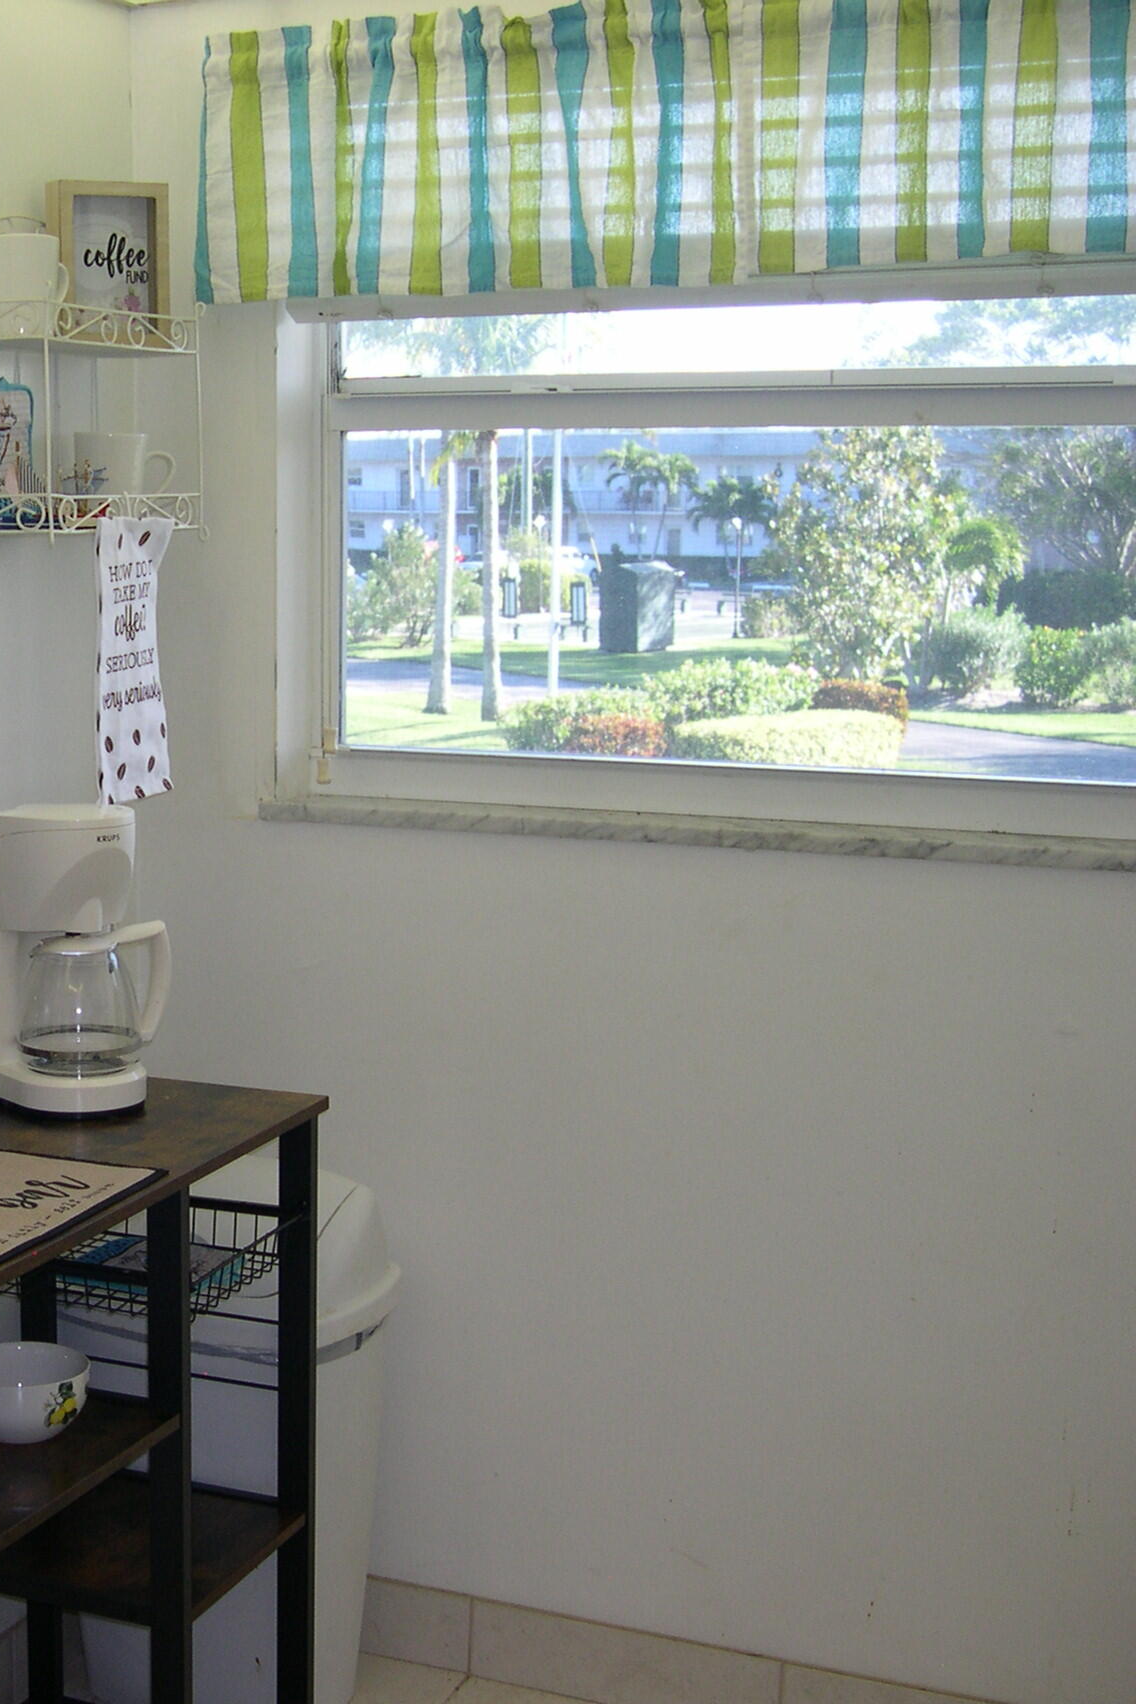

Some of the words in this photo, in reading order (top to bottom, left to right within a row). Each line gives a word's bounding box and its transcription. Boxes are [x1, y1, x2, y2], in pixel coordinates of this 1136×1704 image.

[83, 232, 149, 279] coffee
[125, 269, 149, 285] FUND
[96, 832, 120, 842] KRUPS
